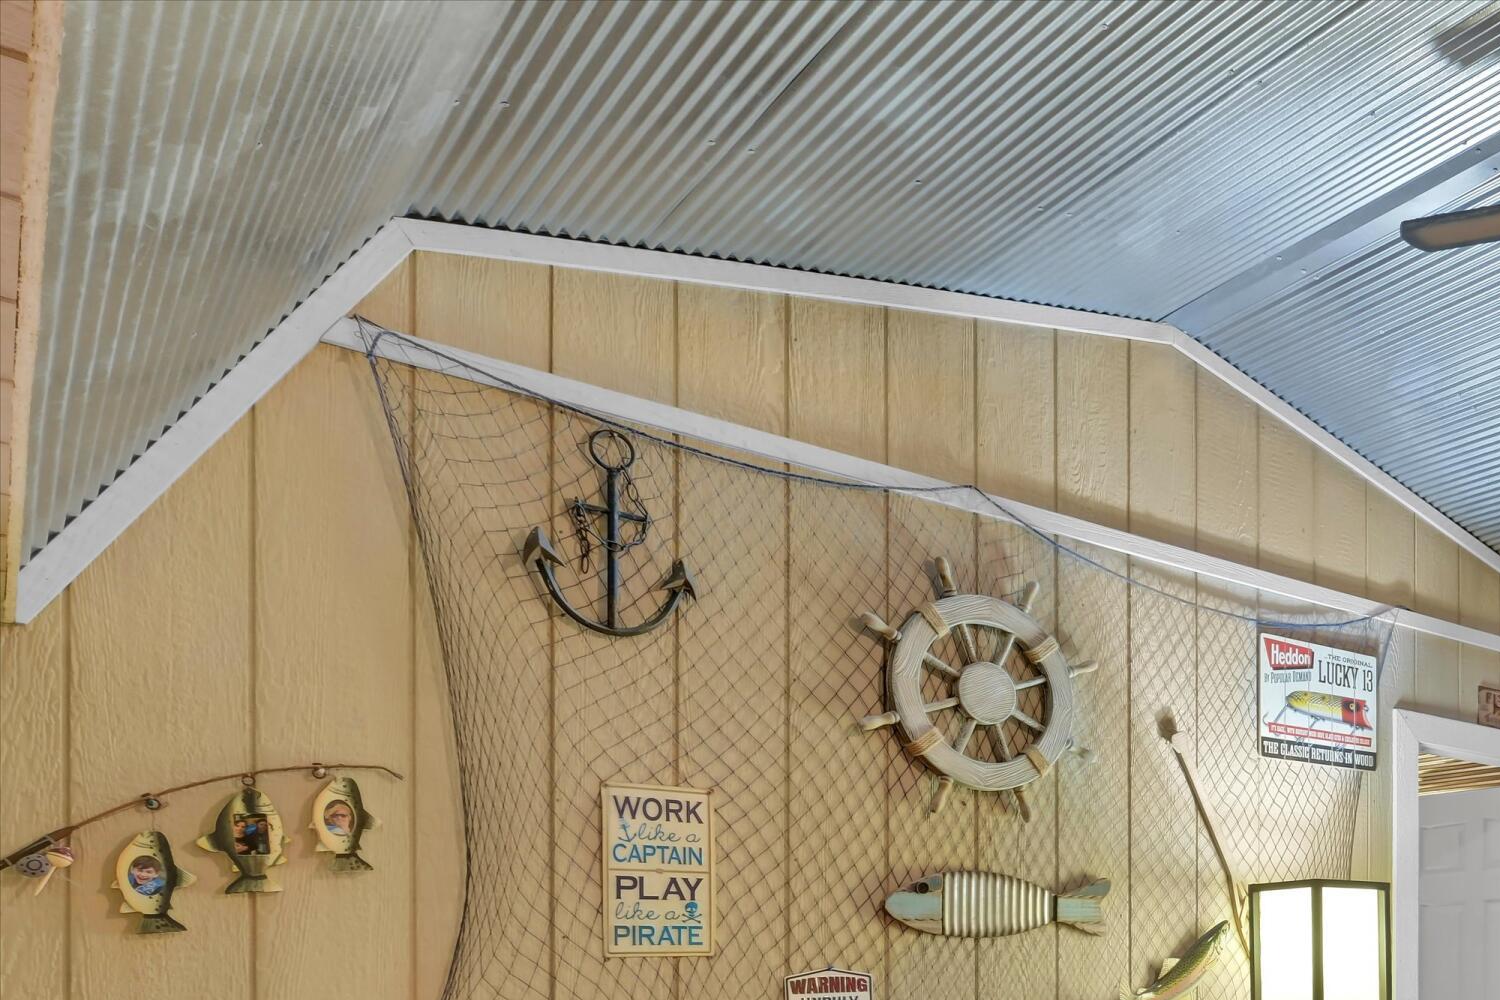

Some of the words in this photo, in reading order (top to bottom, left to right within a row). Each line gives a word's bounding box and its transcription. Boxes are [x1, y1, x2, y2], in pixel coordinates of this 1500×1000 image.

[1271, 643, 1311, 665] Heddon
[1328, 653, 1340, 661] THE
[1318, 659, 1359, 690] LUCKY
[1363, 669, 1373, 692] 13
[1263, 740, 1279, 754] THE
[1280, 743, 1309, 759] CLASSIC
[1311, 747, 1344, 763] RETURNS
[1345, 752, 1353, 764] IN
[1354, 753, 1374, 767] WOOD
[612, 795, 704, 825] WORK
[637, 822, 682, 843] like
[685, 831, 701, 843] a
[612, 843, 704, 866] CAPTAIN
[615, 875, 704, 901] PLAY
[615, 901, 661, 921] like
[664, 909, 681, 921] a
[614, 925, 704, 946] PIRATE
[789, 976, 868, 994] WARNING
